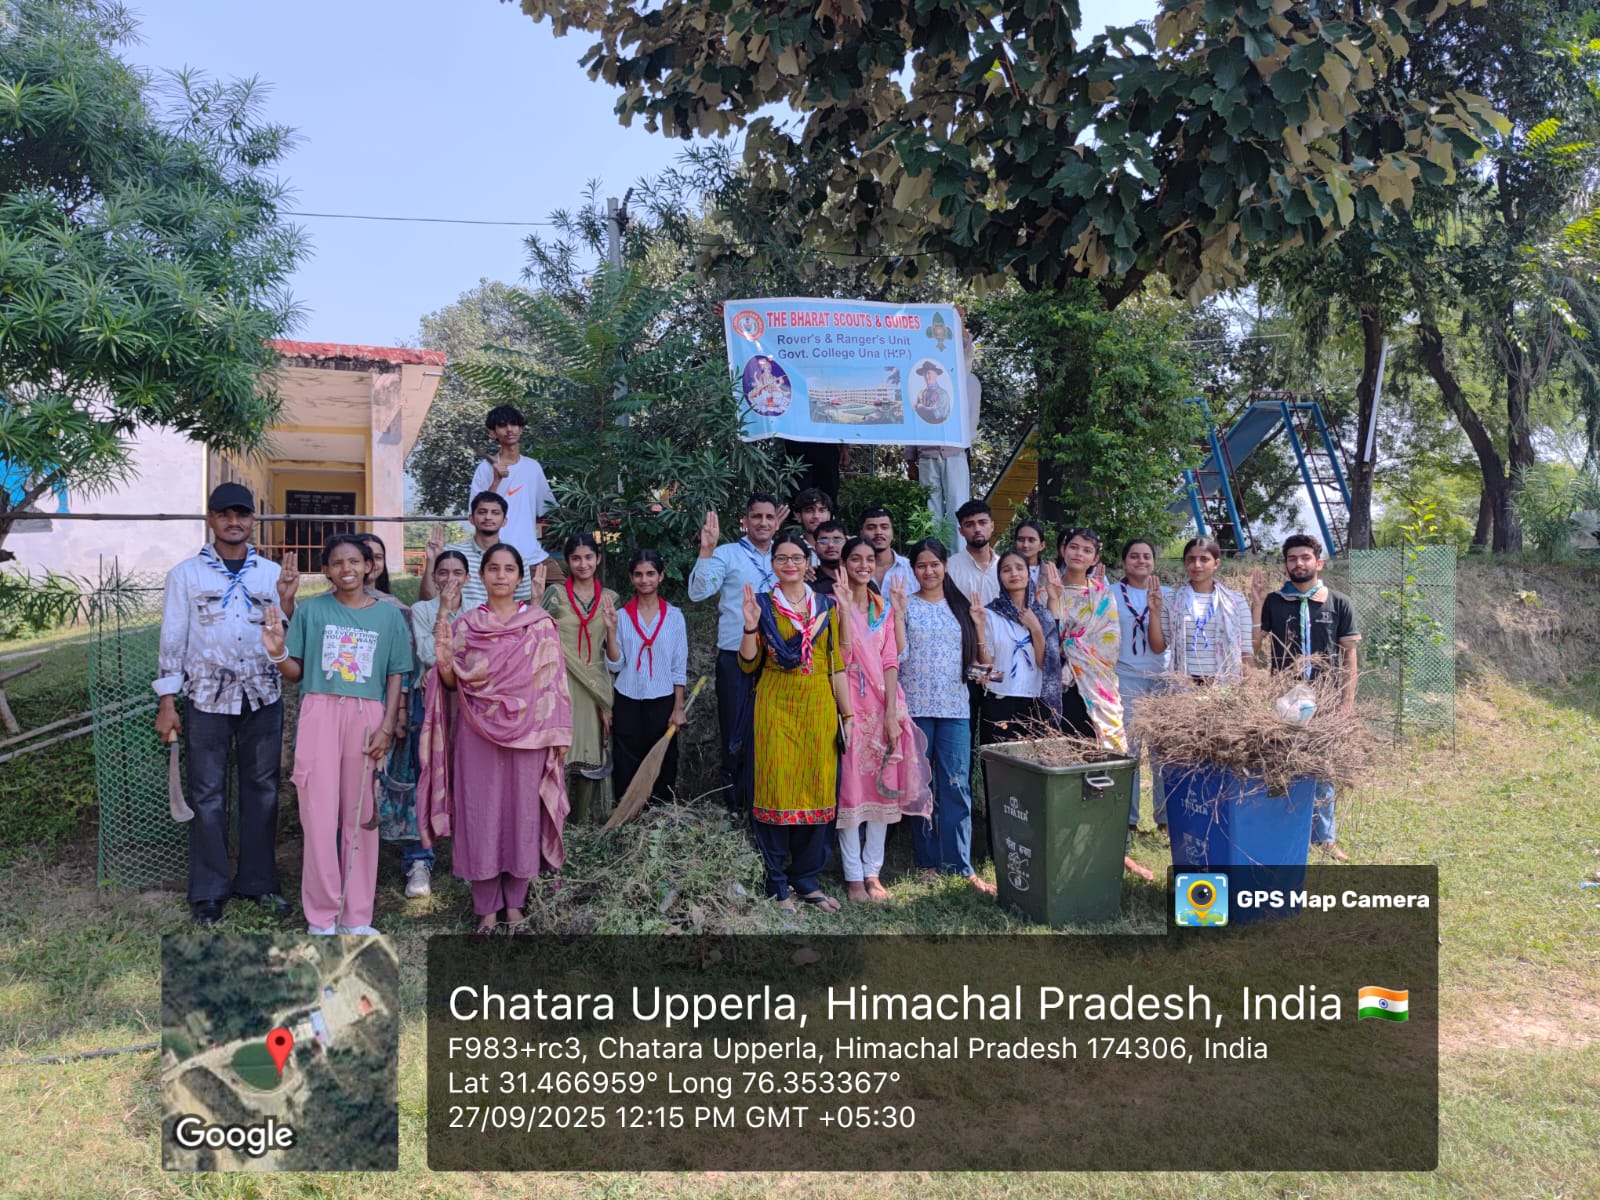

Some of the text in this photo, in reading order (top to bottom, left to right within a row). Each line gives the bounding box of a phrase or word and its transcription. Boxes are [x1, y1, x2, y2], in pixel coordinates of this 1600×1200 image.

[767, 311, 787, 328] THE
[791, 312, 830, 327] BHARAT
[834, 312, 873, 329] SCOUTS
[875, 314, 883, 328] &
[884, 314, 921, 330] GUIDES
[777, 333, 911, 346] Rover's & Ranger's Unit
[778, 348, 809, 360] Govt.
[812, 347, 856, 360] College
[858, 349, 880, 359] Una
